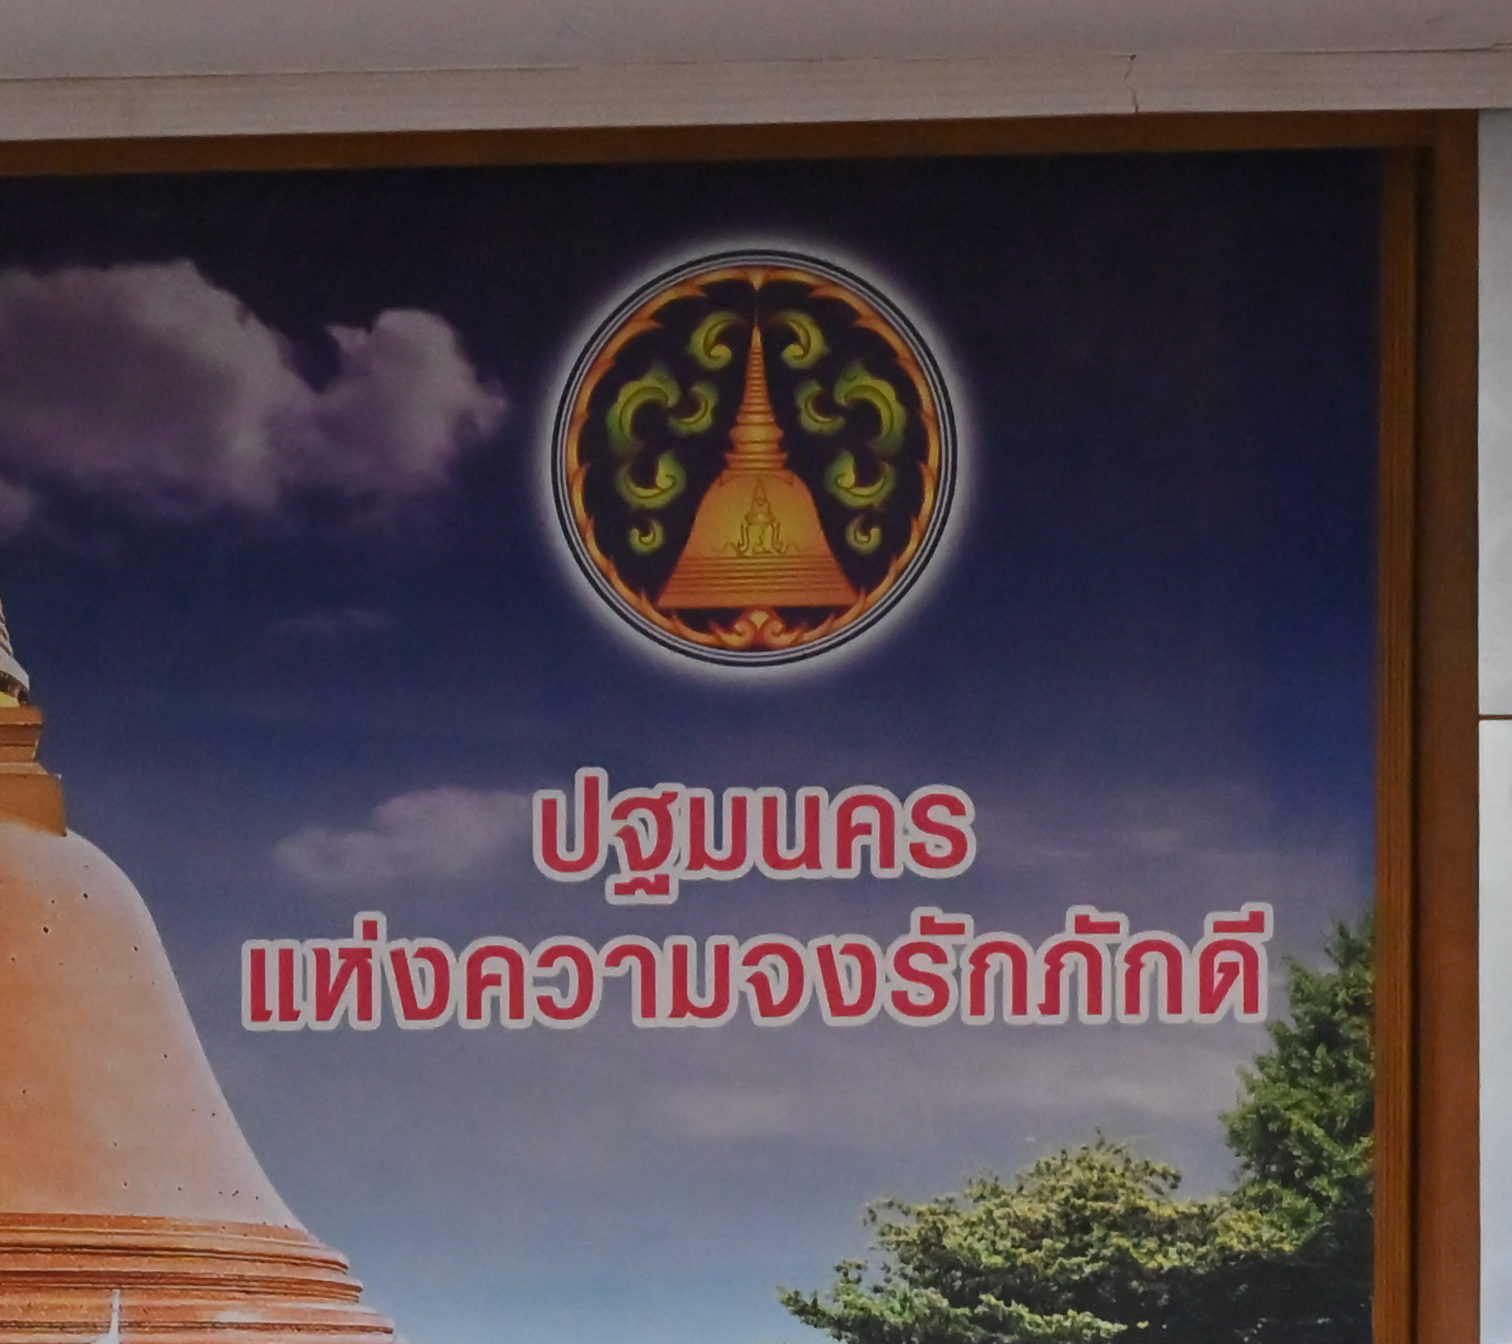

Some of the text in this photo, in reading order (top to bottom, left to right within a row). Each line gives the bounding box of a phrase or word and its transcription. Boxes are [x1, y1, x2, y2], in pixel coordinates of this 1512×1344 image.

[538, 771, 972, 900] ปฐมนคร
[246, 906, 1269, 1026] แห่งความจงรักภักดี
